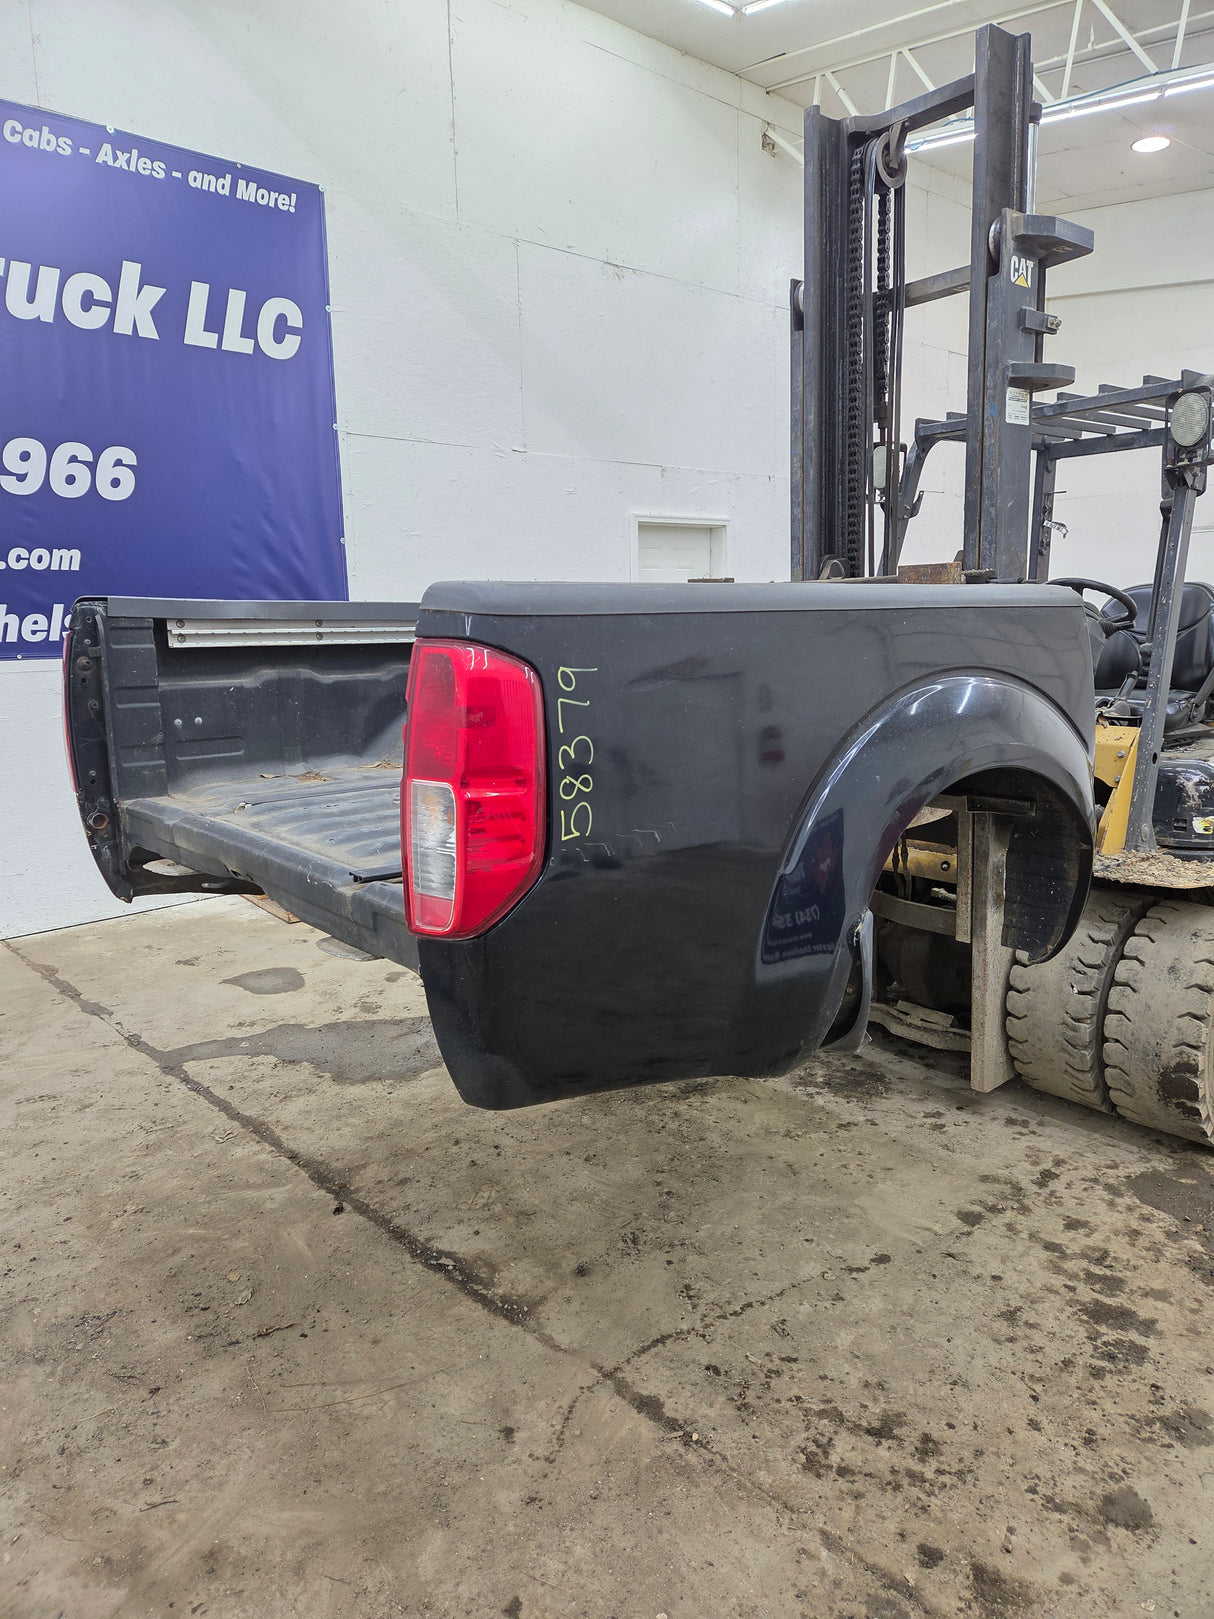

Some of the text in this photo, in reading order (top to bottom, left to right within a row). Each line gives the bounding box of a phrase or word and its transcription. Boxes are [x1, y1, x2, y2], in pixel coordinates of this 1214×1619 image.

[3, 119, 297, 213] Cabs - Axles - and More!
[0, 257, 303, 361] uck LLC
[1010, 255, 1034, 288] CAT
[0, 437, 138, 501] 966
[557, 666, 599, 842] 58379
